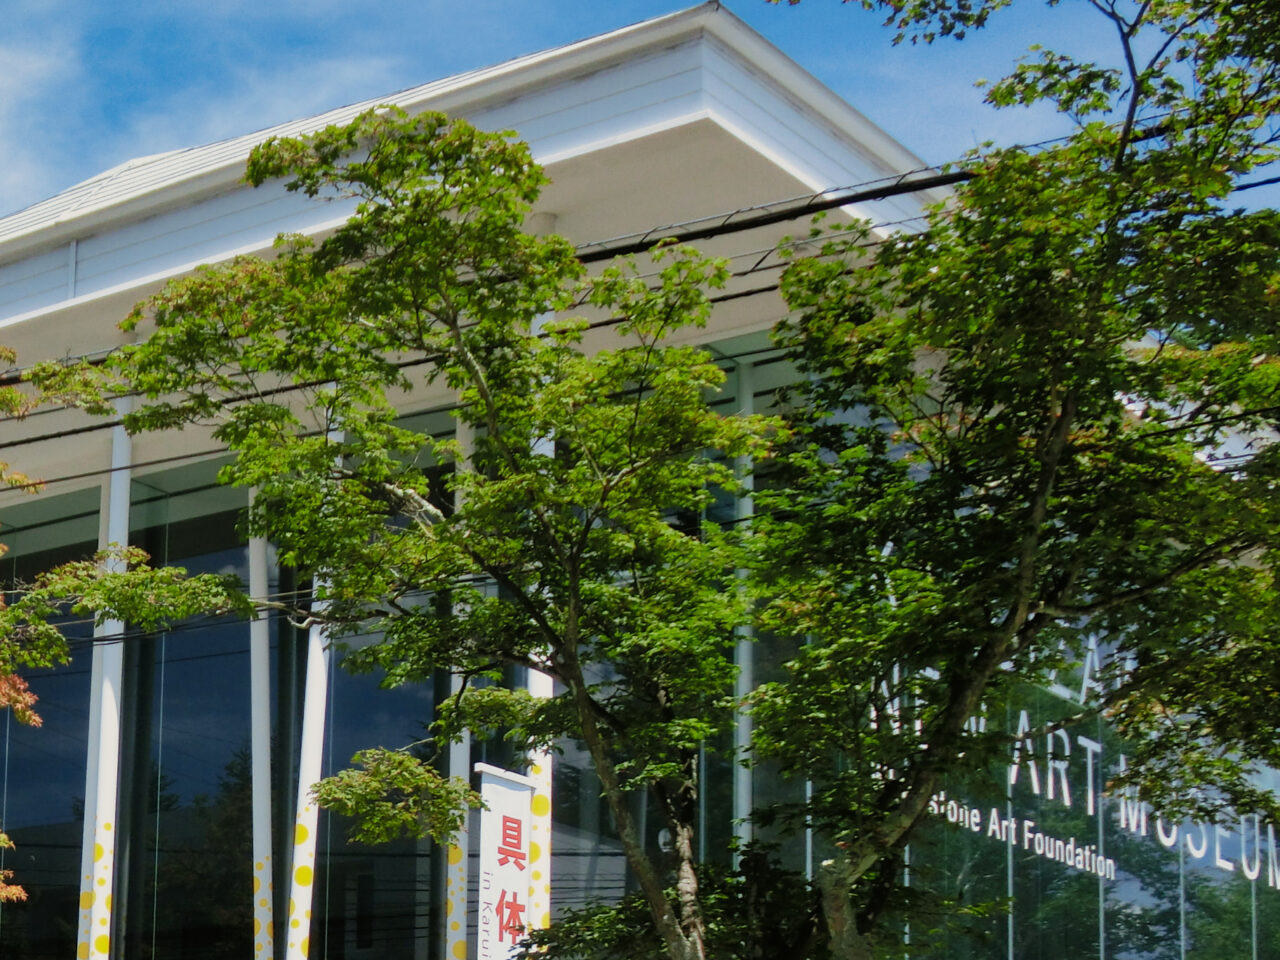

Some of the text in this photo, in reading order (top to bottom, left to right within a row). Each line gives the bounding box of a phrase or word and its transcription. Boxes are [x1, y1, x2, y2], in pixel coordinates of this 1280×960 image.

[1010, 709, 1102, 816] ART
[987, 807, 1017, 845] Art
[1023, 819, 1116, 881] Foundation
